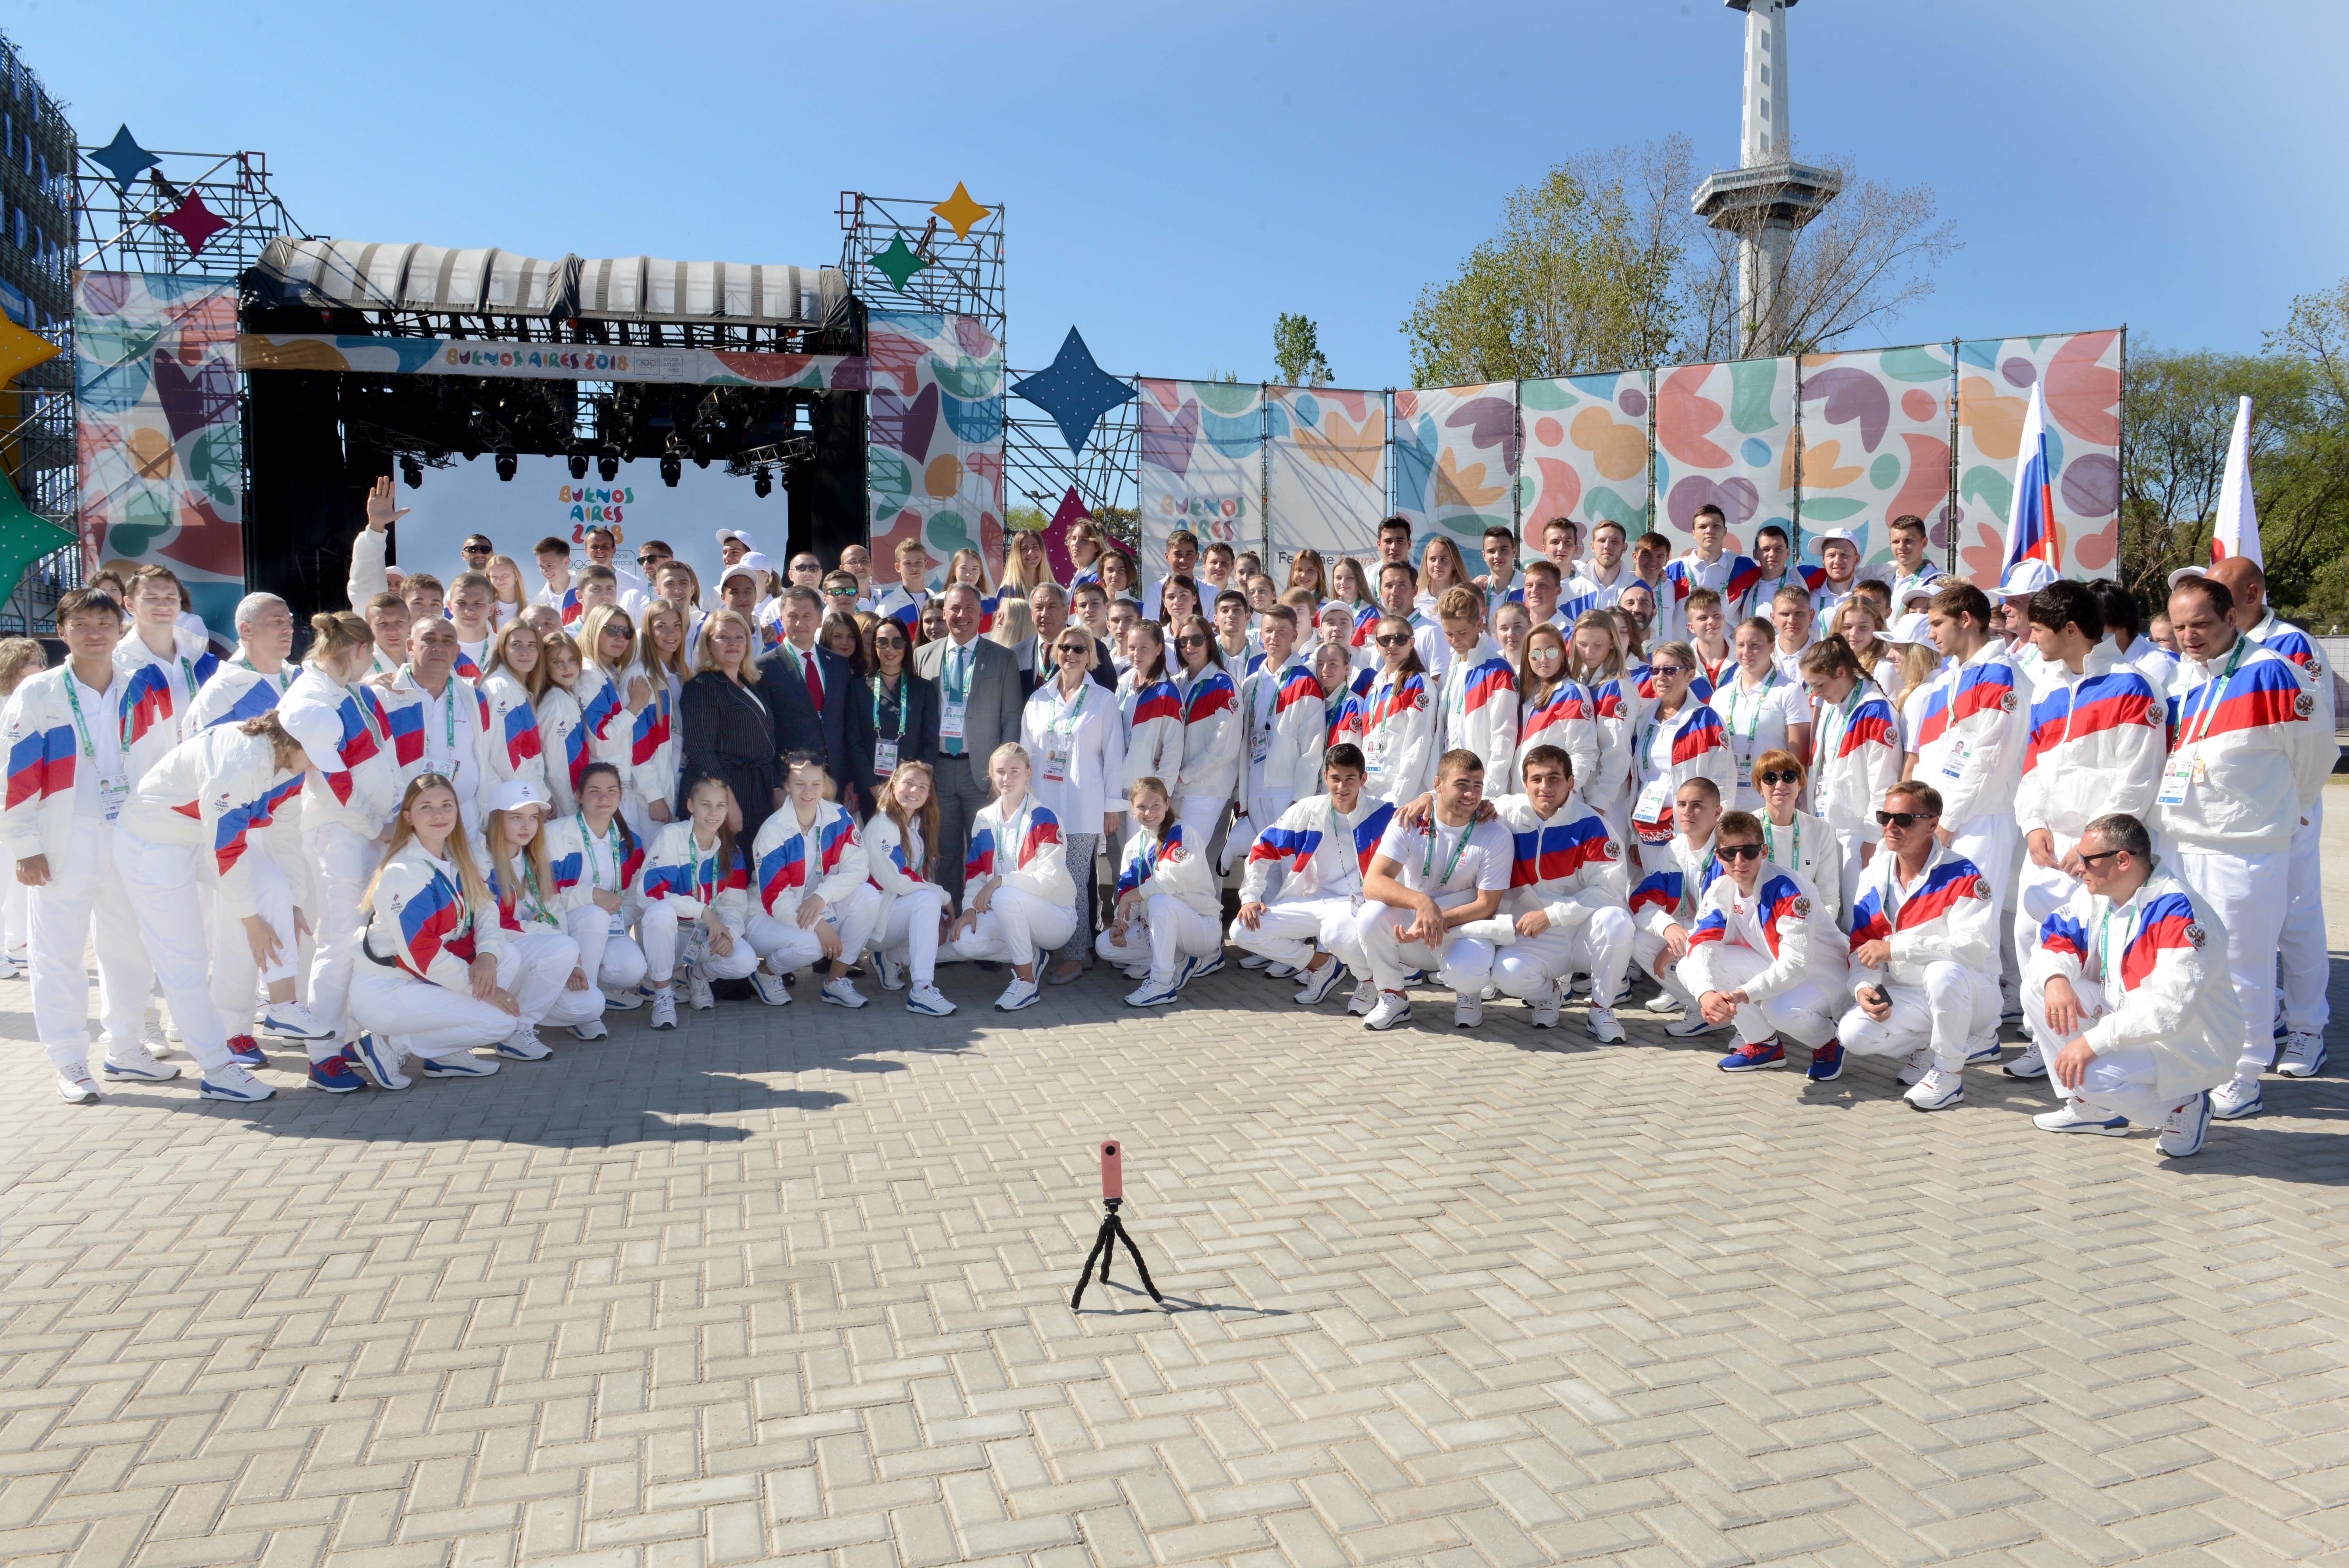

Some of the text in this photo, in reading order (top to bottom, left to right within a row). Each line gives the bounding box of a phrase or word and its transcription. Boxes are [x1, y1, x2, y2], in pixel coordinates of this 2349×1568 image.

[446, 347, 628, 371] BUENOS AIRES 2018
[559, 485, 634, 504] BUENOS
[570, 504, 623, 523] AIRES
[1160, 494, 1246, 518] BUENOS
[1173, 519, 1234, 541] AIRES
[1279, 552, 1376, 566] Fe he fture
